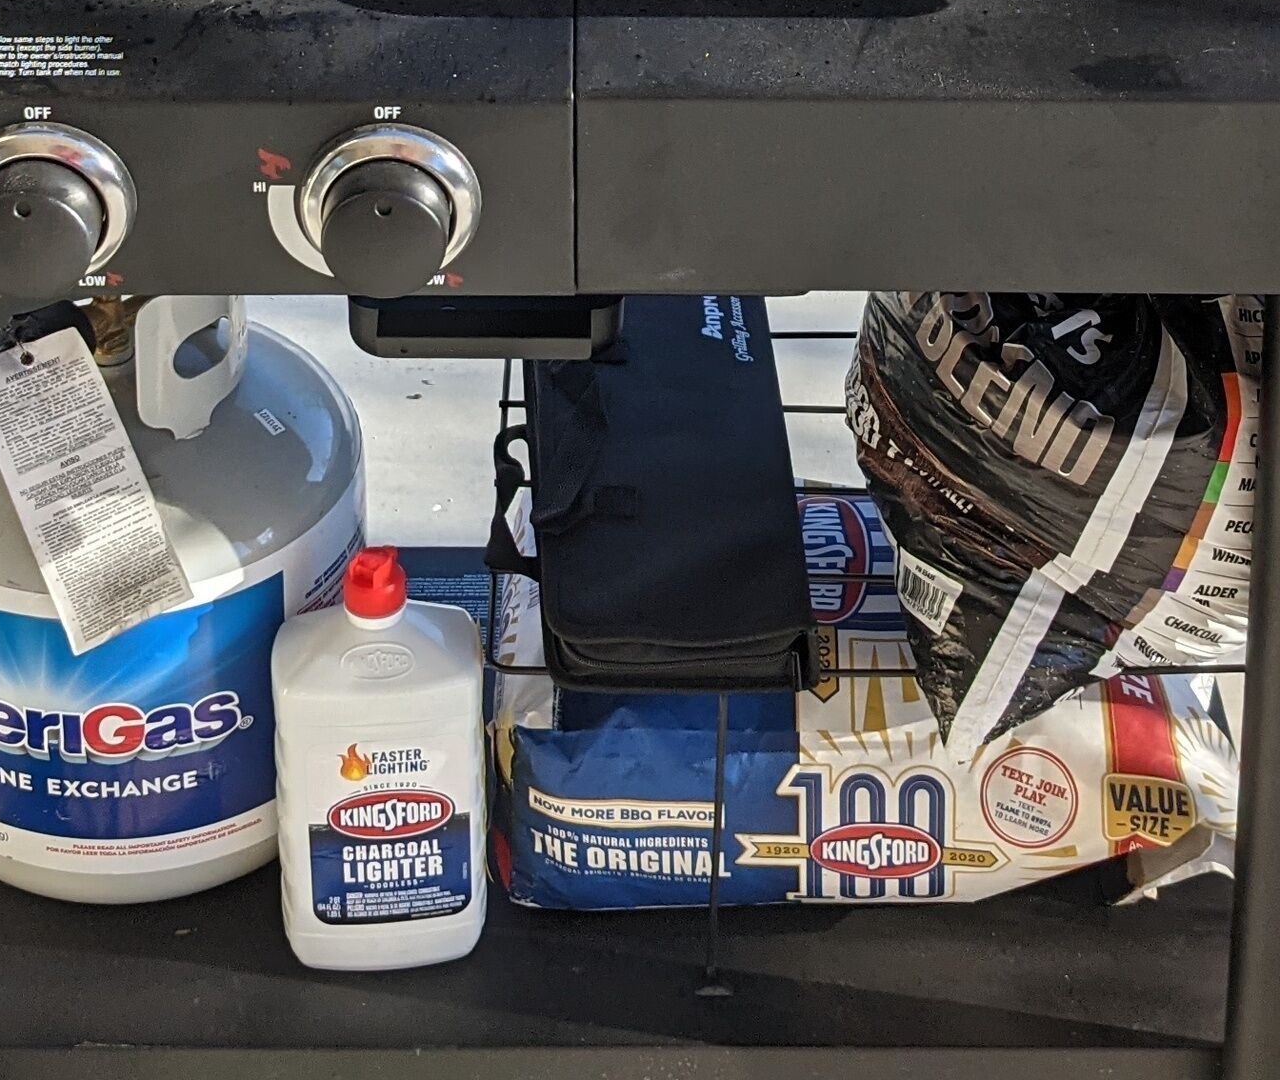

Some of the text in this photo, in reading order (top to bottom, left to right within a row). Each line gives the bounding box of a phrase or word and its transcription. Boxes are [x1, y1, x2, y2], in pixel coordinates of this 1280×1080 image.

[24, 106, 52, 120] OFF
[374, 107, 401, 119] OFF
[253, 182, 266, 193] HI
[730, 296, 746, 330] Accessor
[1194, 585, 1238, 599] ALDER
[1164, 616, 1223, 643] CHARCOAL
[366, 759, 428, 775] LIGHTING
[372, 749, 421, 763] FASTER
[47, 769, 198, 799] EXCHANGE
[363, 782, 390, 791] SINCE
[1001, 765, 1068, 800] TEXT. JOIN.
[1014, 784, 1047, 806] PLAY.
[1109, 782, 1190, 817] VALUE
[340, 799, 442, 830] KINGSFORD
[533, 795, 566, 814] NOW
[571, 807, 615, 820] MORE
[620, 809, 652, 820] BBQ
[996, 802, 1020, 815] FLAME
[1018, 801, 1035, 812] TEXT
[995, 810, 1049, 836] TO LEARN MORE
[1129, 814, 1170, 837] SIZE
[547, 824, 708, 848] 100% NATURAL INGREDIENTS
[789, 772, 946, 898] 100
[342, 839, 442, 861] CHARCOAL
[530, 827, 732, 878] THE ORIGINAL
[766, 845, 800, 855] 1920
[821, 833, 929, 870] KINGSFORD
[949, 852, 986, 864] 2020
[343, 855, 443, 883] LIGHTER
[370, 879, 418, 889] ODORLESS
